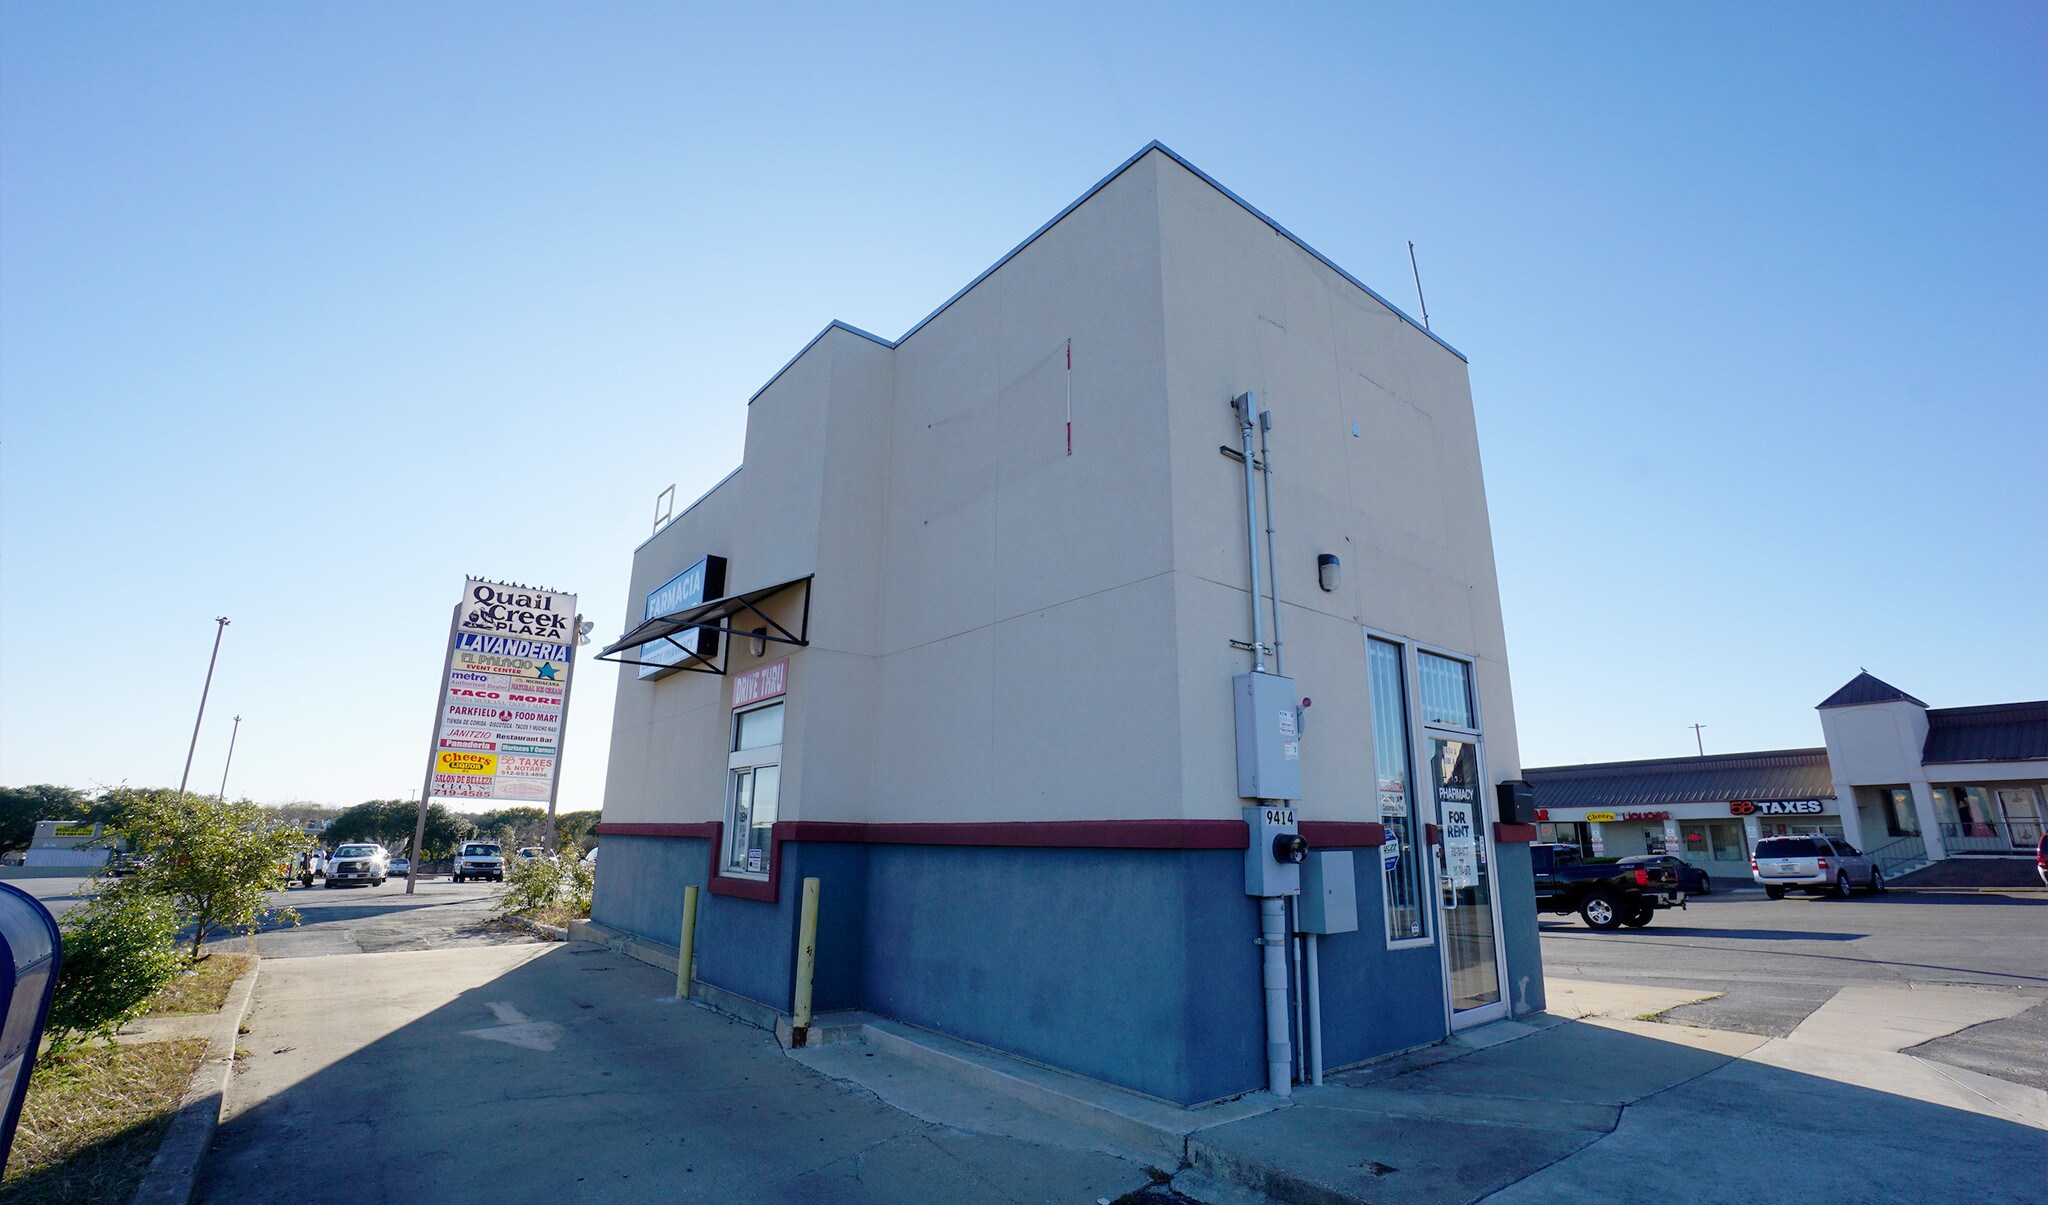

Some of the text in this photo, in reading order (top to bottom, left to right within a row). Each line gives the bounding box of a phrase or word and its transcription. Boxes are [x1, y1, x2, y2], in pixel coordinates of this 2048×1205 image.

[474, 586, 552, 611] Quail
[649, 570, 700, 619] FARMACIA
[488, 604, 568, 630] Creek
[496, 622, 561, 639] PLAZA
[460, 632, 567, 662] LAVANDERIA
[461, 653, 533, 669] EL PALACIO
[466, 664, 522, 674] EVENT CENTER
[451, 680, 486, 688] Authorized
[511, 683, 534, 692] NATURAL
[545, 687, 562, 695] CREAM
[736, 663, 784, 704] DRIVE THRU
[450, 688, 561, 705] TACO MORE
[449, 706, 497, 717] PARKFIELD
[515, 712, 535, 720] FOOD
[537, 714, 558, 723] MART
[447, 729, 491, 739] JANITZIO
[496, 734, 538, 742] Restaurant
[446, 740, 490, 750] Panaderia
[442, 753, 491, 765] Cheers
[501, 756, 552, 767] 58 TAXES
[435, 774, 456, 783] SALON
[466, 776, 492, 785] BELLEZA
[434, 789, 491, 797] 719-4585
[1439, 787, 1474, 800] PHARMACY
[1730, 800, 1822, 815] 58 TAXES
[1266, 810, 1294, 826] 9414
[1448, 810, 1466, 824] FOR
[1587, 811, 1670, 821] Cheers LIQUORS
[1448, 825, 1469, 838] RENT
